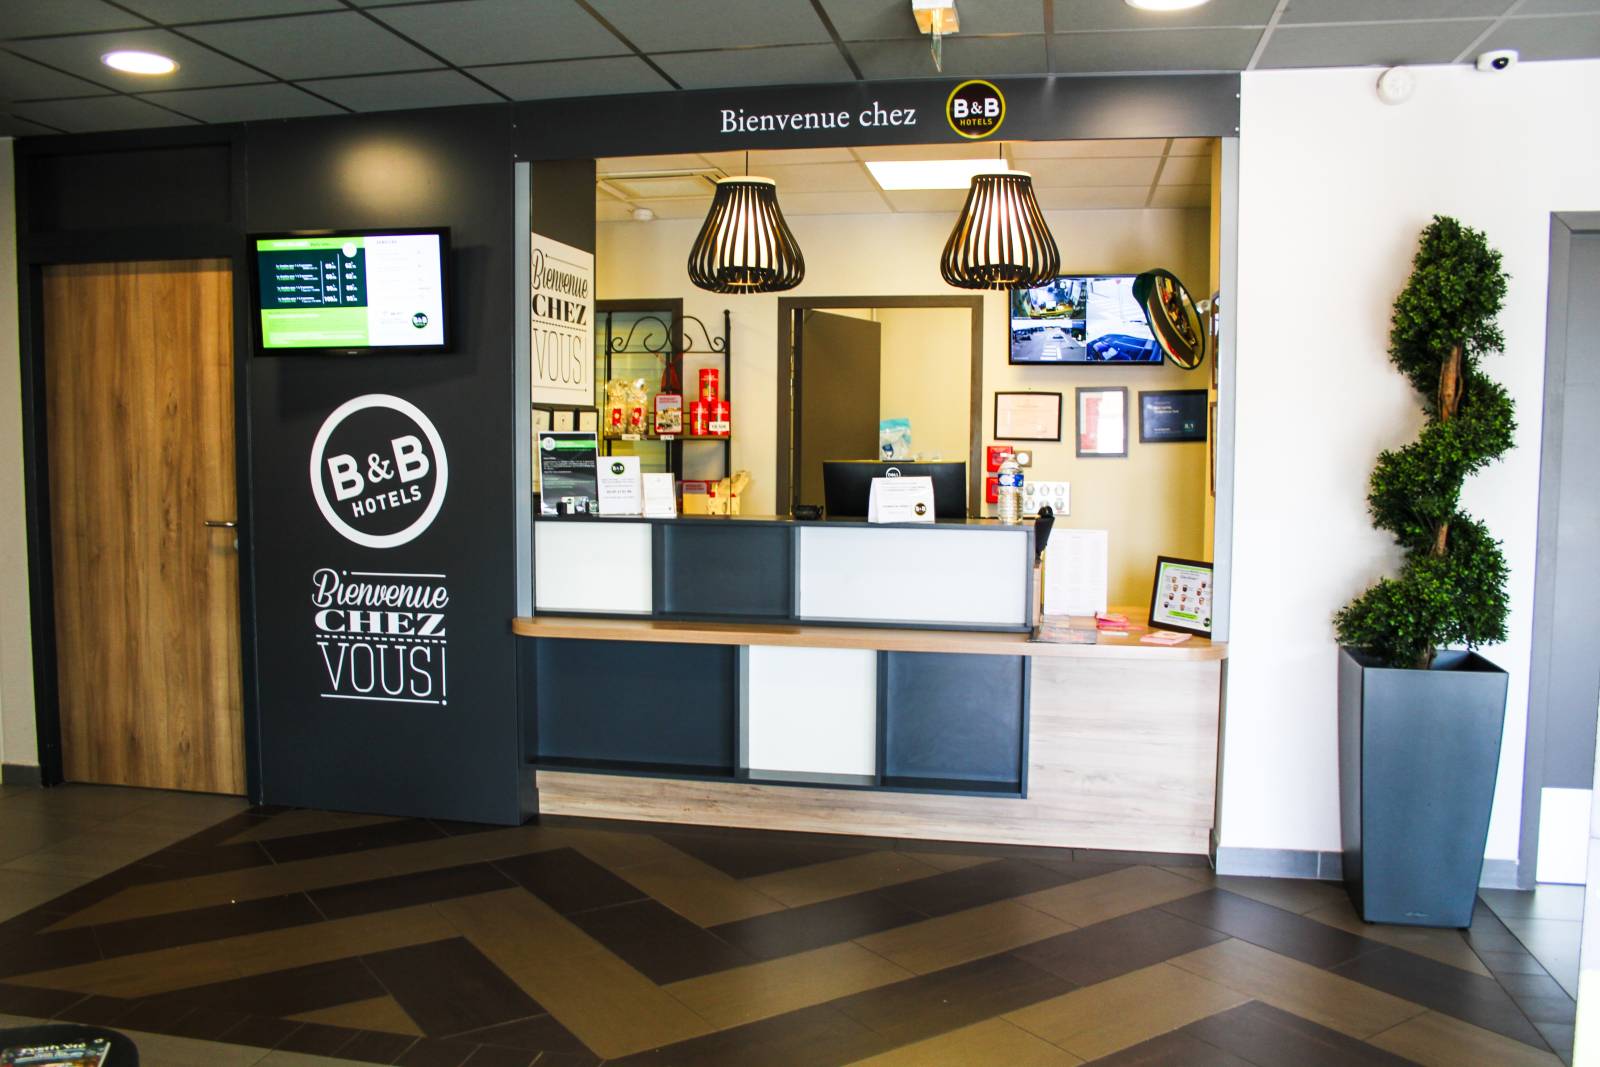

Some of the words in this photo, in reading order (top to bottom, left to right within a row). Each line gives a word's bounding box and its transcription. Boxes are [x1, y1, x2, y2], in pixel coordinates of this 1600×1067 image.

[720, 108, 850, 133] Bienvenue
[859, 101, 917, 127] chez
[953, 97, 1000, 119] B&B
[960, 118, 993, 127] HOTELS
[531, 248, 588, 299] Bienvenue
[532, 293, 587, 326] CHEZ
[327, 435, 430, 502] B&B
[352, 485, 422, 518] HOTELS
[312, 568, 449, 608] Bienvenue
[314, 609, 446, 637] CHEZ
[316, 641, 447, 706] VOUS!
